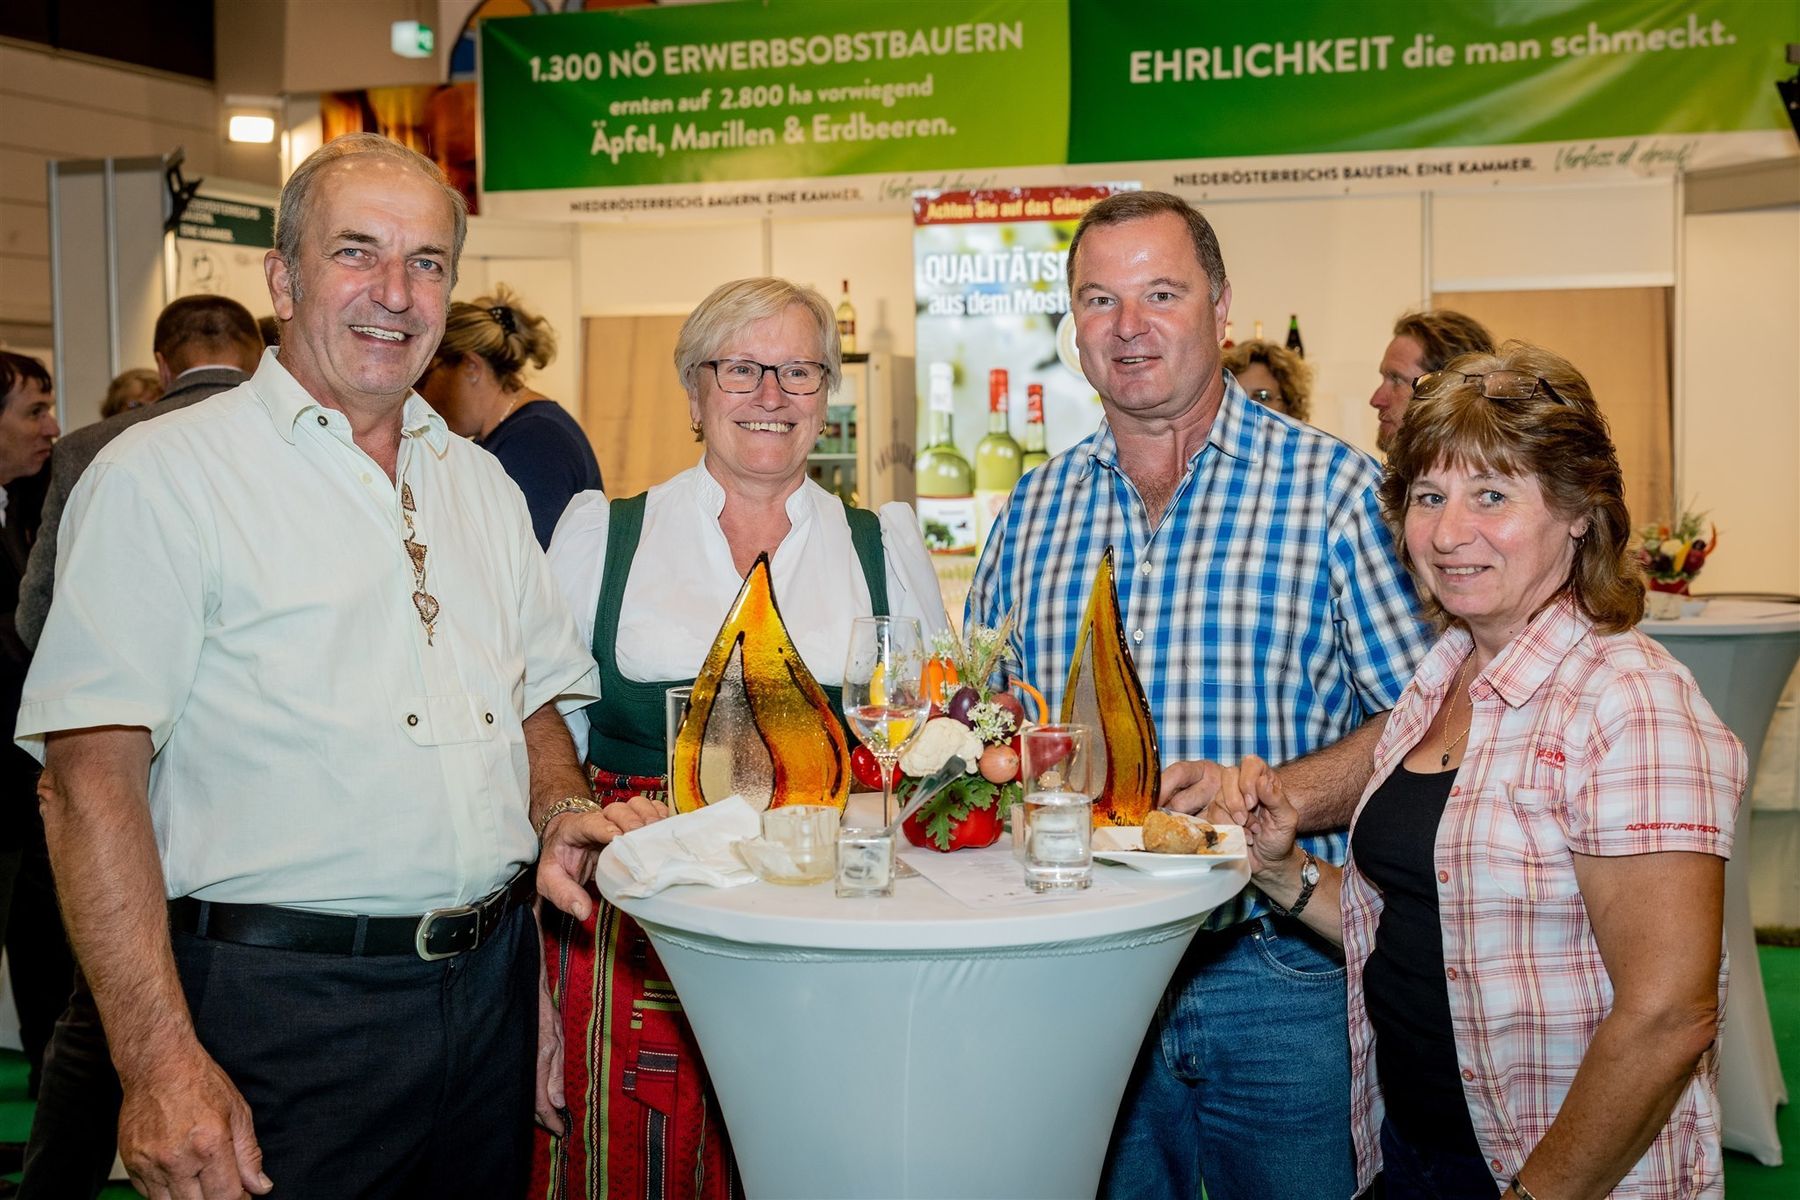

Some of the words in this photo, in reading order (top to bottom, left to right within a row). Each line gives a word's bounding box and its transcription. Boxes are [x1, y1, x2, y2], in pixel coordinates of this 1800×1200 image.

[529, 52, 602, 82] 1.300
[608, 41, 657, 79] NÖ
[663, 20, 1023, 75] ERWERBSOBSTBAUERN
[1129, 35, 1394, 84] EHRLICHKEIT
[1402, 33, 1455, 68] die
[1465, 38, 1541, 65] man
[1551, 12, 1737, 58] schmeckt.
[609, 96, 674, 116] ernten
[677, 88, 712, 112] auf
[719, 84, 784, 110] 2.800
[788, 83, 813, 105] ha
[817, 73, 934, 107] vorwiegend
[590, 120, 665, 165] Äpfel,
[670, 118, 776, 150] Marillen
[783, 115, 805, 144] &
[812, 111, 957, 143] Erdbeeren.
[1174, 167, 1337, 187] NIEDERÖSTERREICHS
[1417, 160, 1453, 176] EINE
[767, 191, 797, 203] EINE
[975, 199, 998, 218] Sie
[1000, 199, 1023, 217] auf
[1025, 198, 1050, 216] das
[928, 291, 965, 315] aus
[967, 289, 1012, 315] dem
